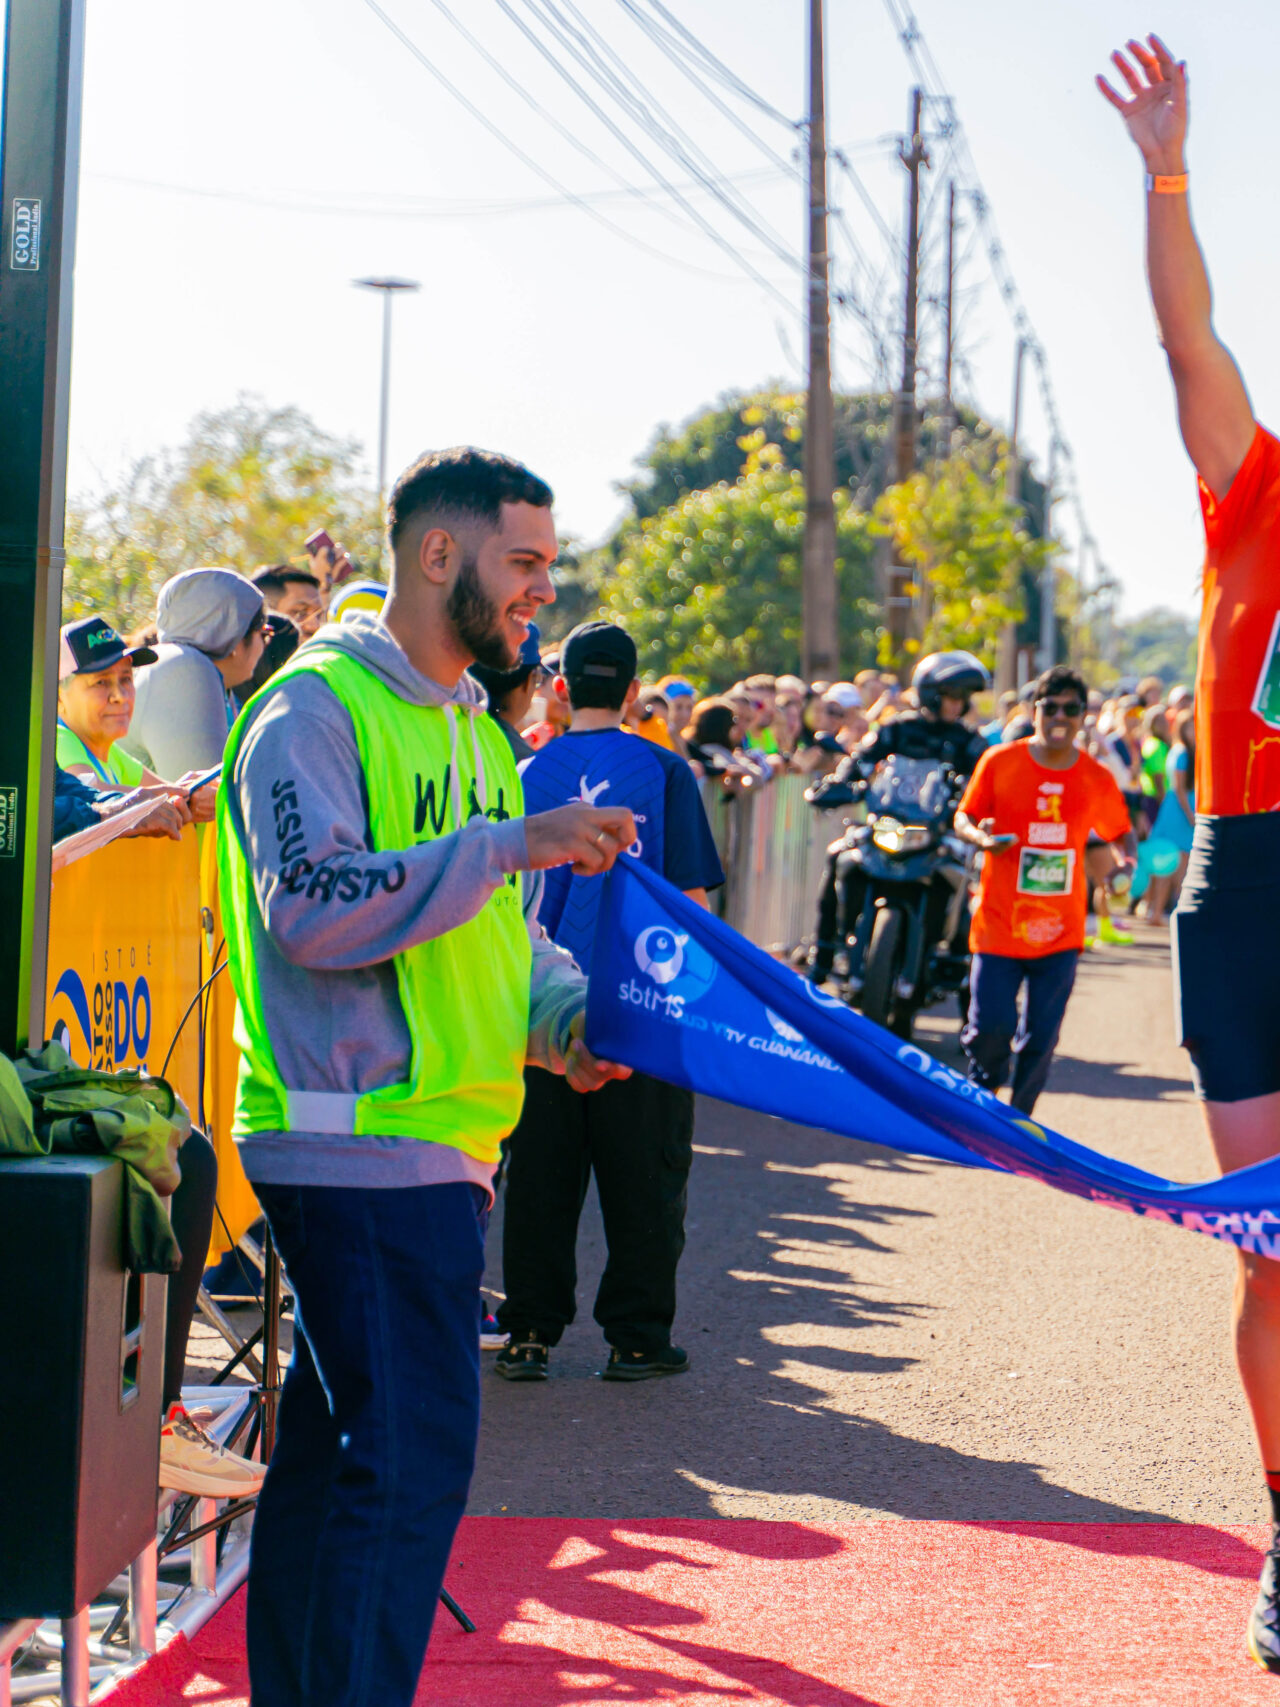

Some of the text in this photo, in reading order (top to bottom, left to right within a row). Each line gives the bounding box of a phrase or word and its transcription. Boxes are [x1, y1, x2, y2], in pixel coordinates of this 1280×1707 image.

[15, 206, 31, 263] GOLD
[114, 975, 151, 1064] DO
[725, 1027, 747, 1044] TV
